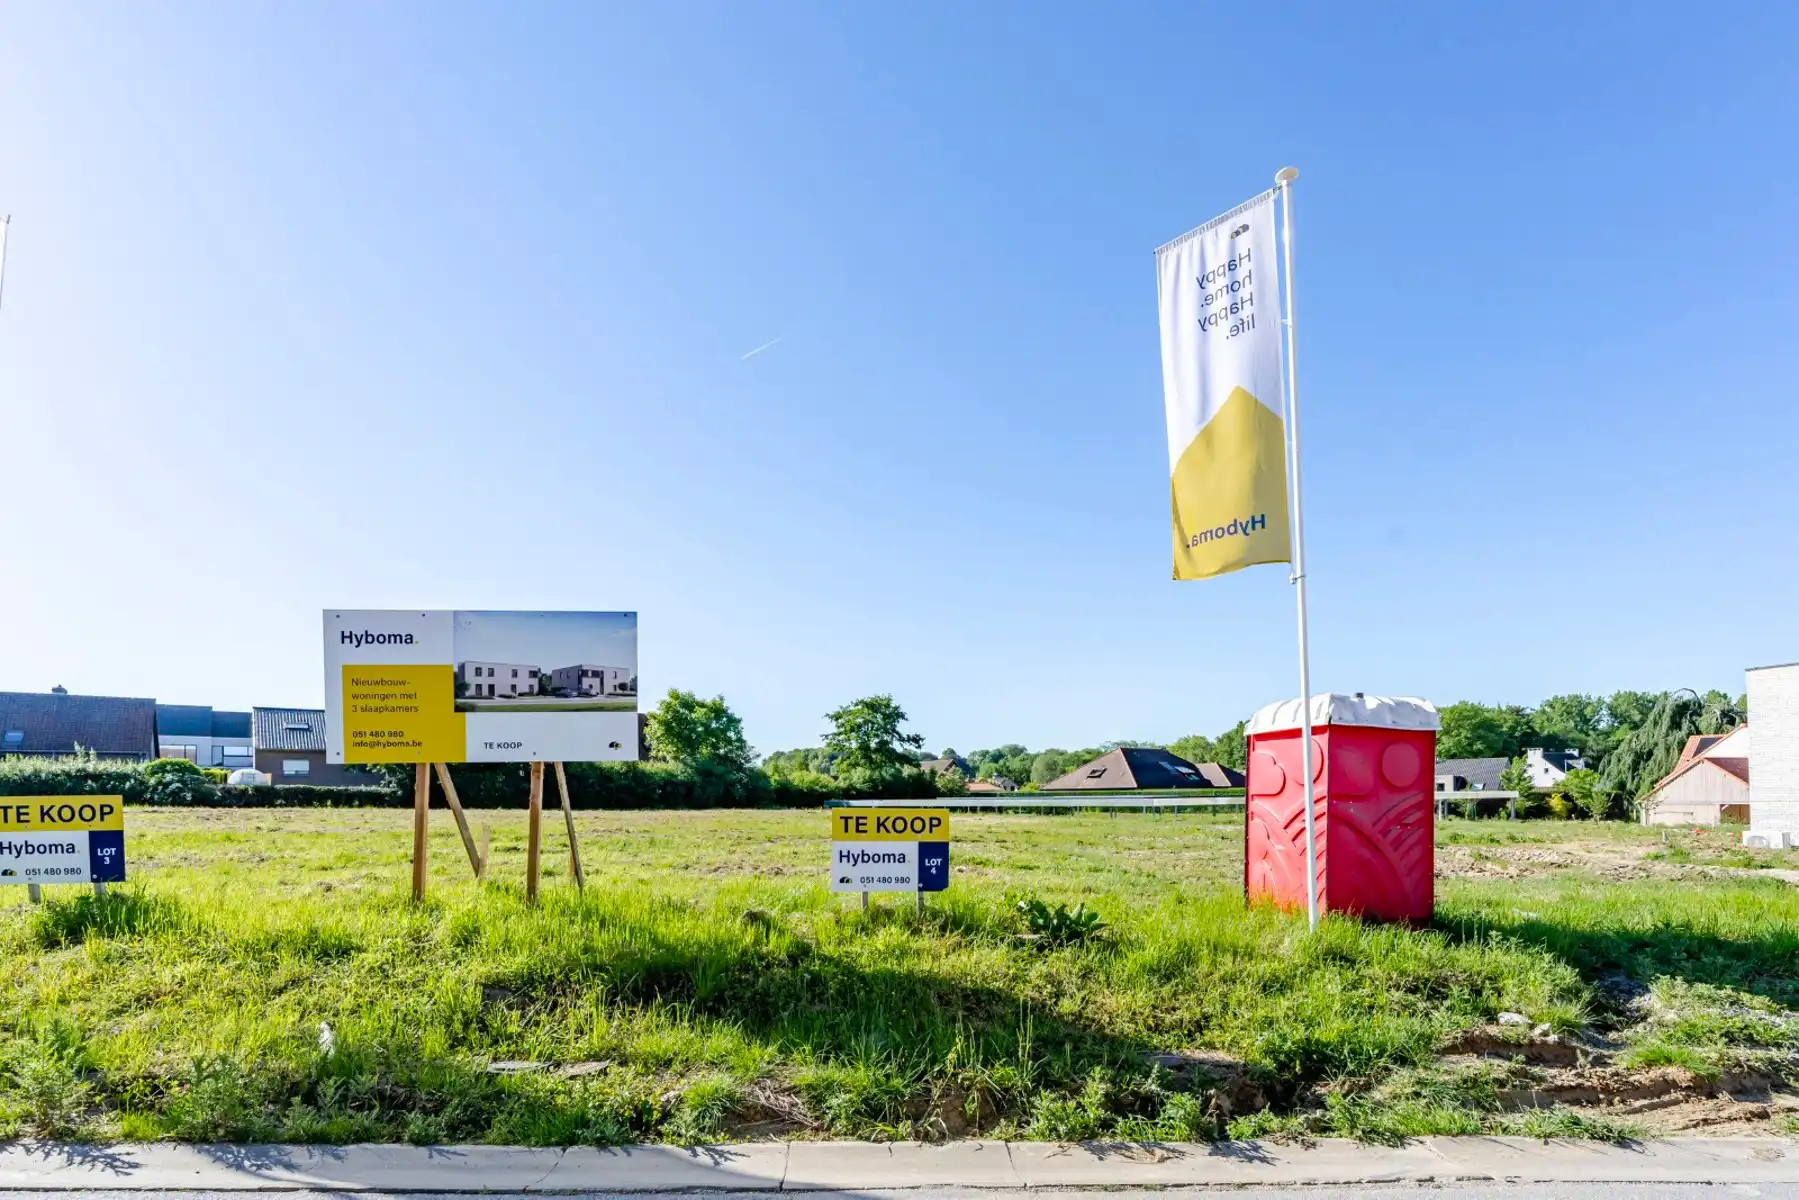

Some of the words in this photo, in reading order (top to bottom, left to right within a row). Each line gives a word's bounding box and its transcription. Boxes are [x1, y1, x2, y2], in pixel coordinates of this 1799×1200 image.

[351, 678, 410, 687] Nieuwbouw-
[351, 692, 397, 701] woningen
[400, 692, 417, 700] met
[351, 704, 358, 713] 3
[360, 704, 419, 714] slaapkamers
[352, 730, 367, 738] 051
[369, 730, 385, 738] 480
[387, 730, 404, 738] 980
[352, 739, 423, 749] info@hyboma.be
[483, 741, 494, 750] TE
[496, 741, 523, 750] KOOP
[0, 804, 31, 824] TE
[39, 803, 115, 823] KOOP
[839, 816, 868, 834] TE
[876, 816, 942, 834] KOOP
[97, 847, 117, 856] LOT
[103, 856, 110, 865] 3
[925, 858, 943, 867] LOT
[25, 868, 41, 876] 051
[43, 868, 62, 876] 480
[63, 867, 82, 876] 980
[930, 866, 937, 875] 4
[860, 876, 875, 884] 051
[876, 876, 893, 884] 480
[894, 876, 911, 884] 980
